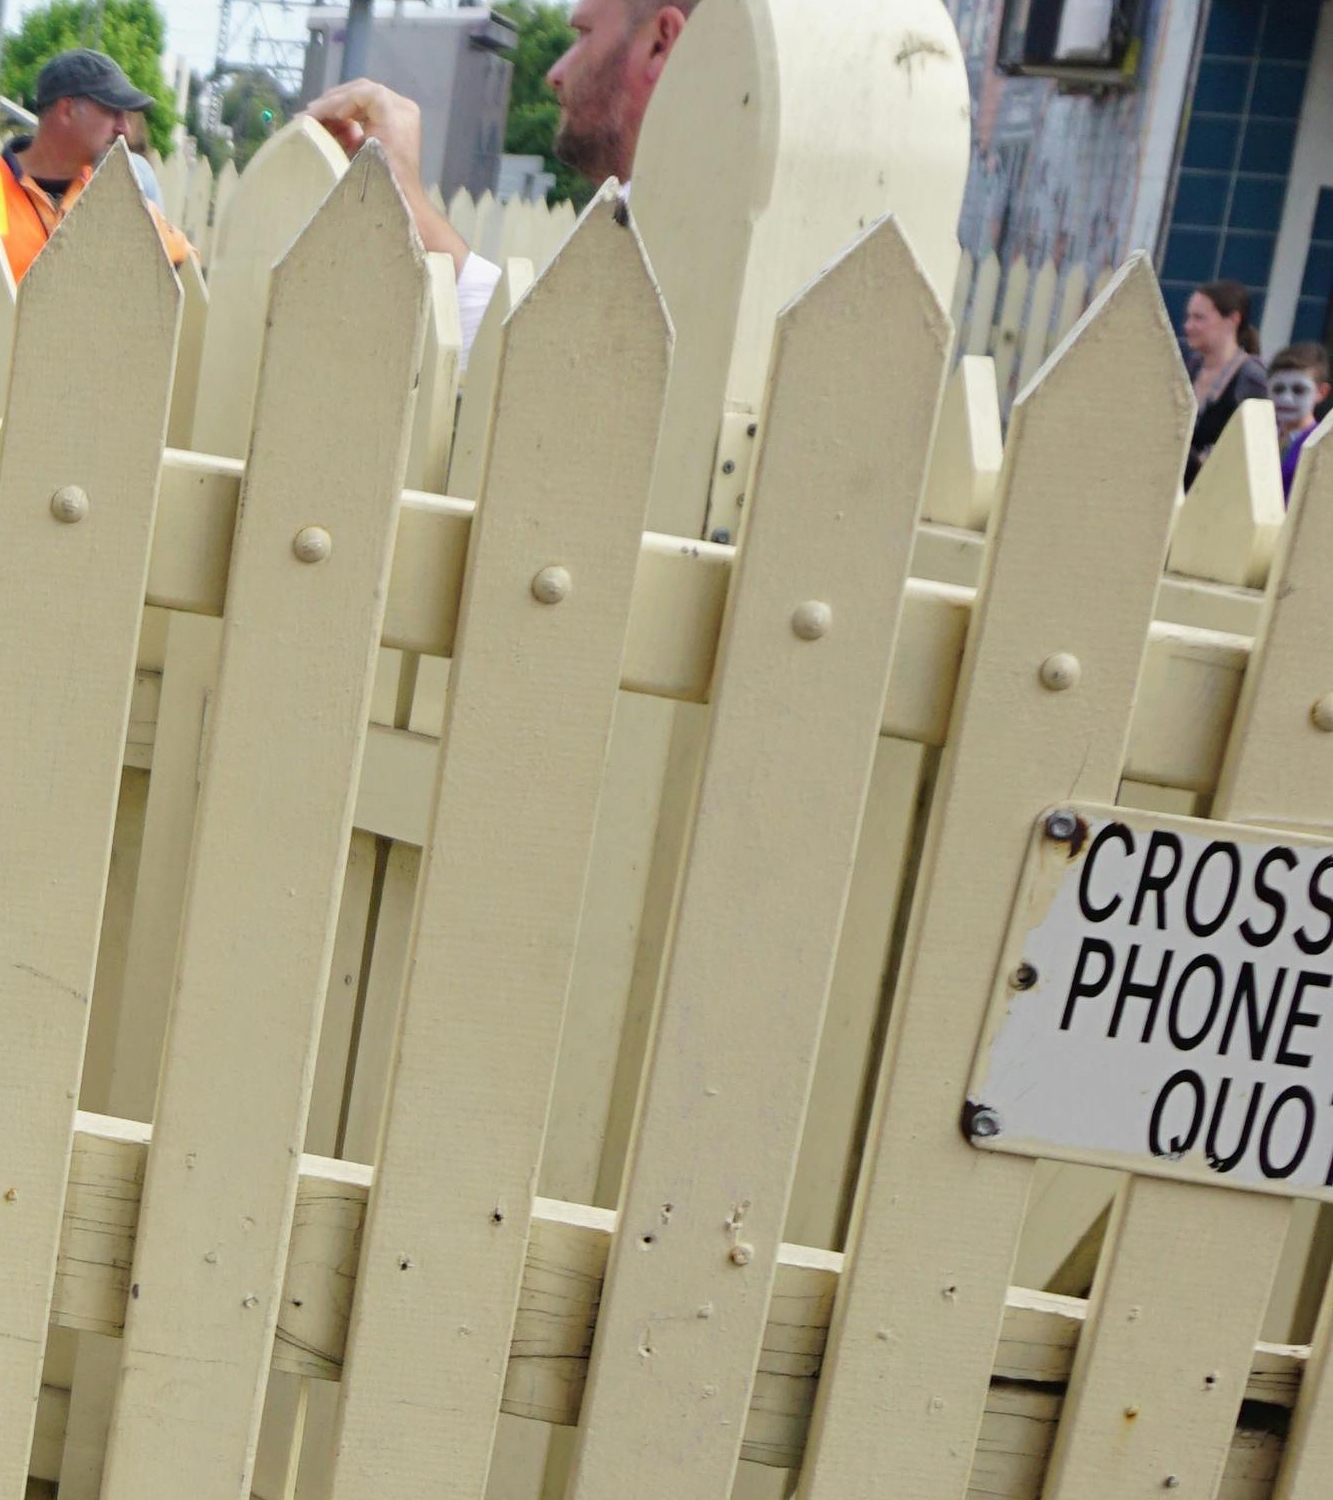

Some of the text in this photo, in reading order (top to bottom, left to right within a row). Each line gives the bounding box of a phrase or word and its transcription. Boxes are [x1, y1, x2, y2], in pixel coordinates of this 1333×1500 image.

[1078, 820, 1333, 956] CROSS
[1060, 935, 1333, 1068] PHONE
[1148, 1068, 1333, 1187] QUO
